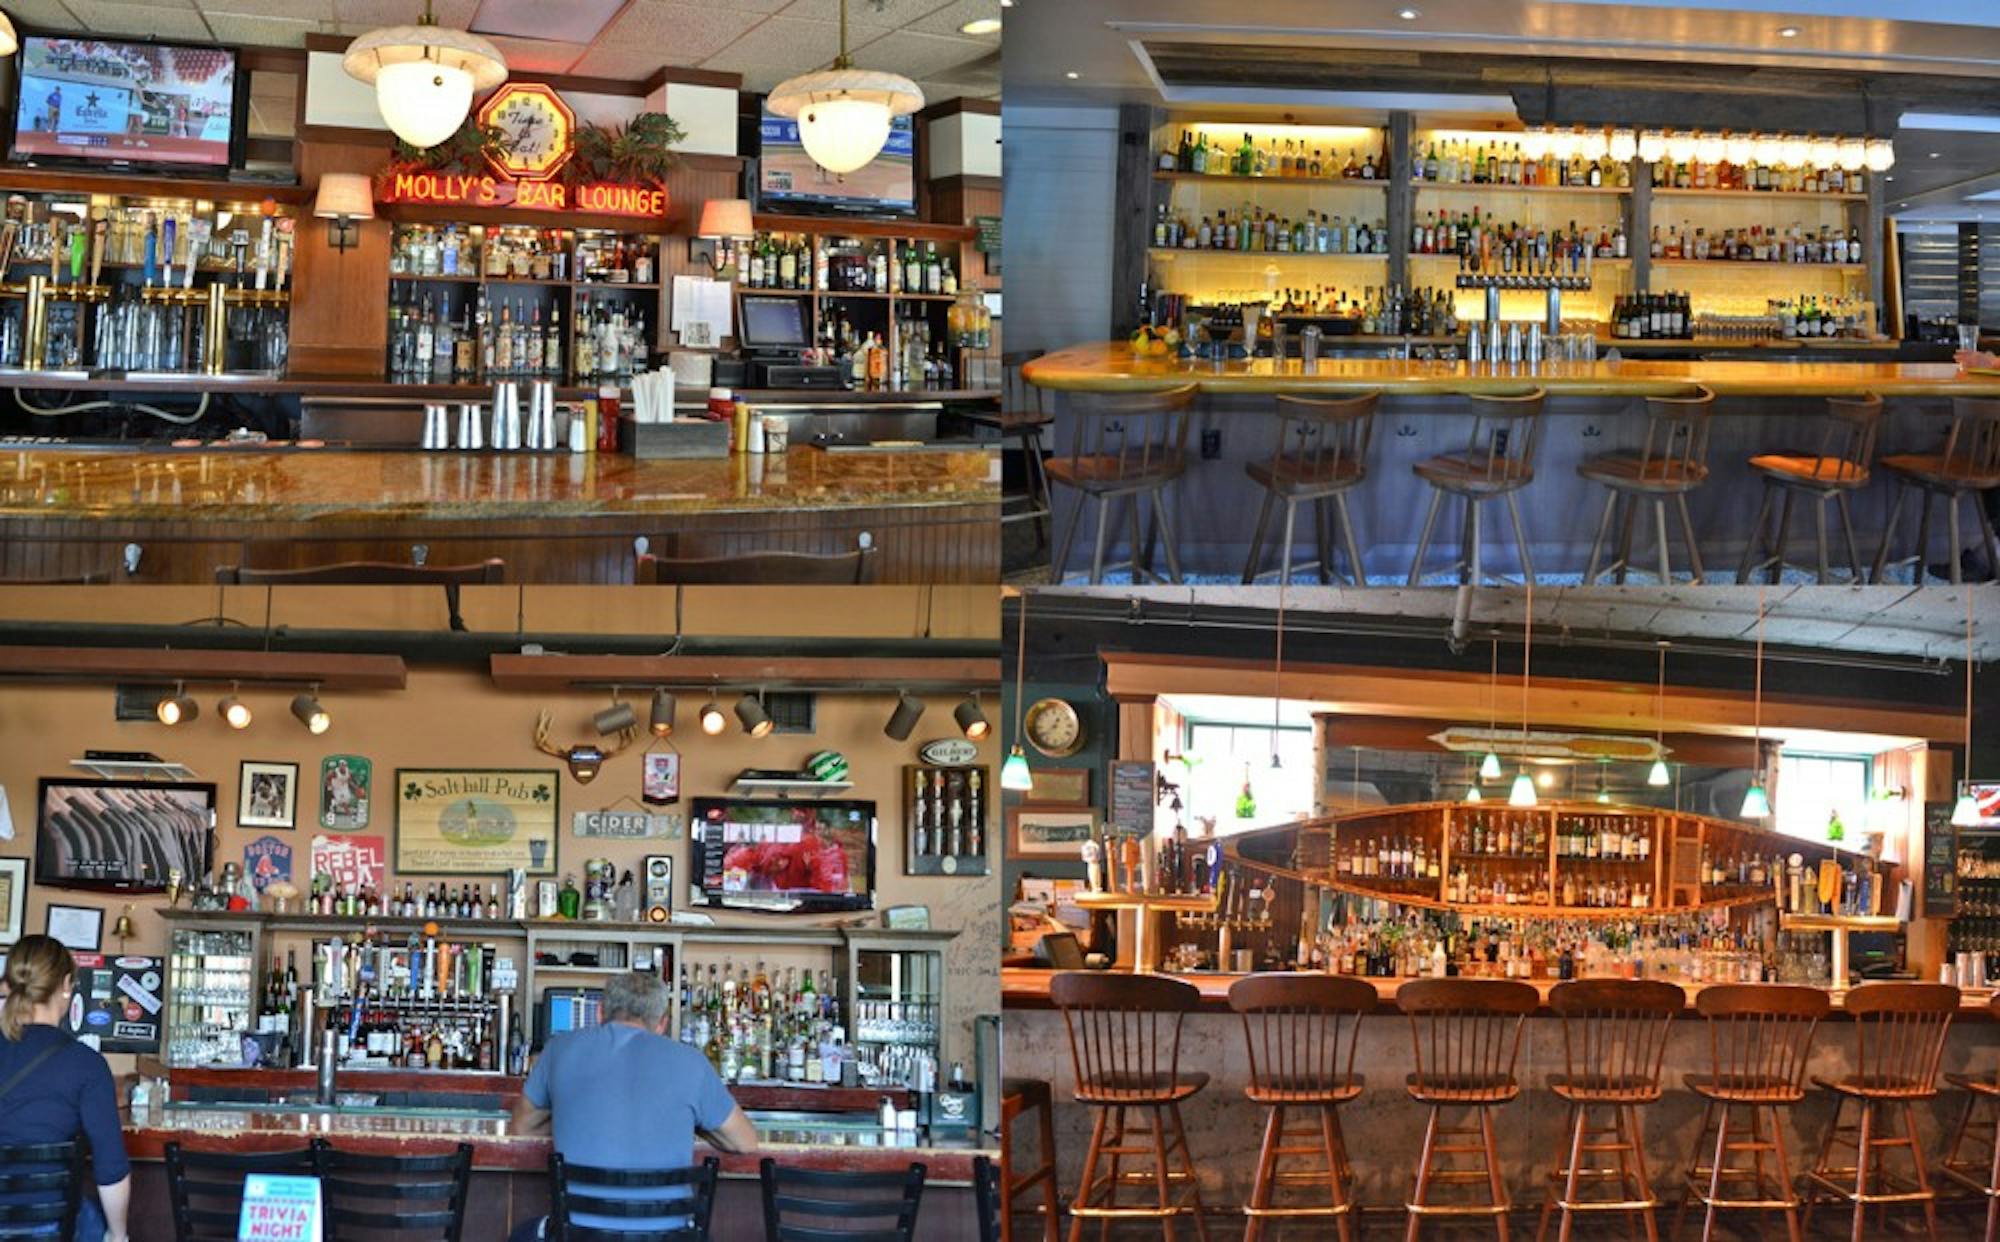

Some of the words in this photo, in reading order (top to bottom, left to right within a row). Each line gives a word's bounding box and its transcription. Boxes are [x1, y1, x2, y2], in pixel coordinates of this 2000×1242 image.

[394, 174, 496, 201] MOLLY'S
[516, 180, 565, 208] BAR
[580, 185, 665, 215] LOUNGE
[495, 777, 530, 800] Pub
[588, 816, 645, 829] CIDER
[247, 842, 289, 857] BOSTON
[315, 847, 385, 872] REBEL
[249, 1205, 307, 1222] TRIVIA
[250, 1221, 303, 1239] NIGHT
